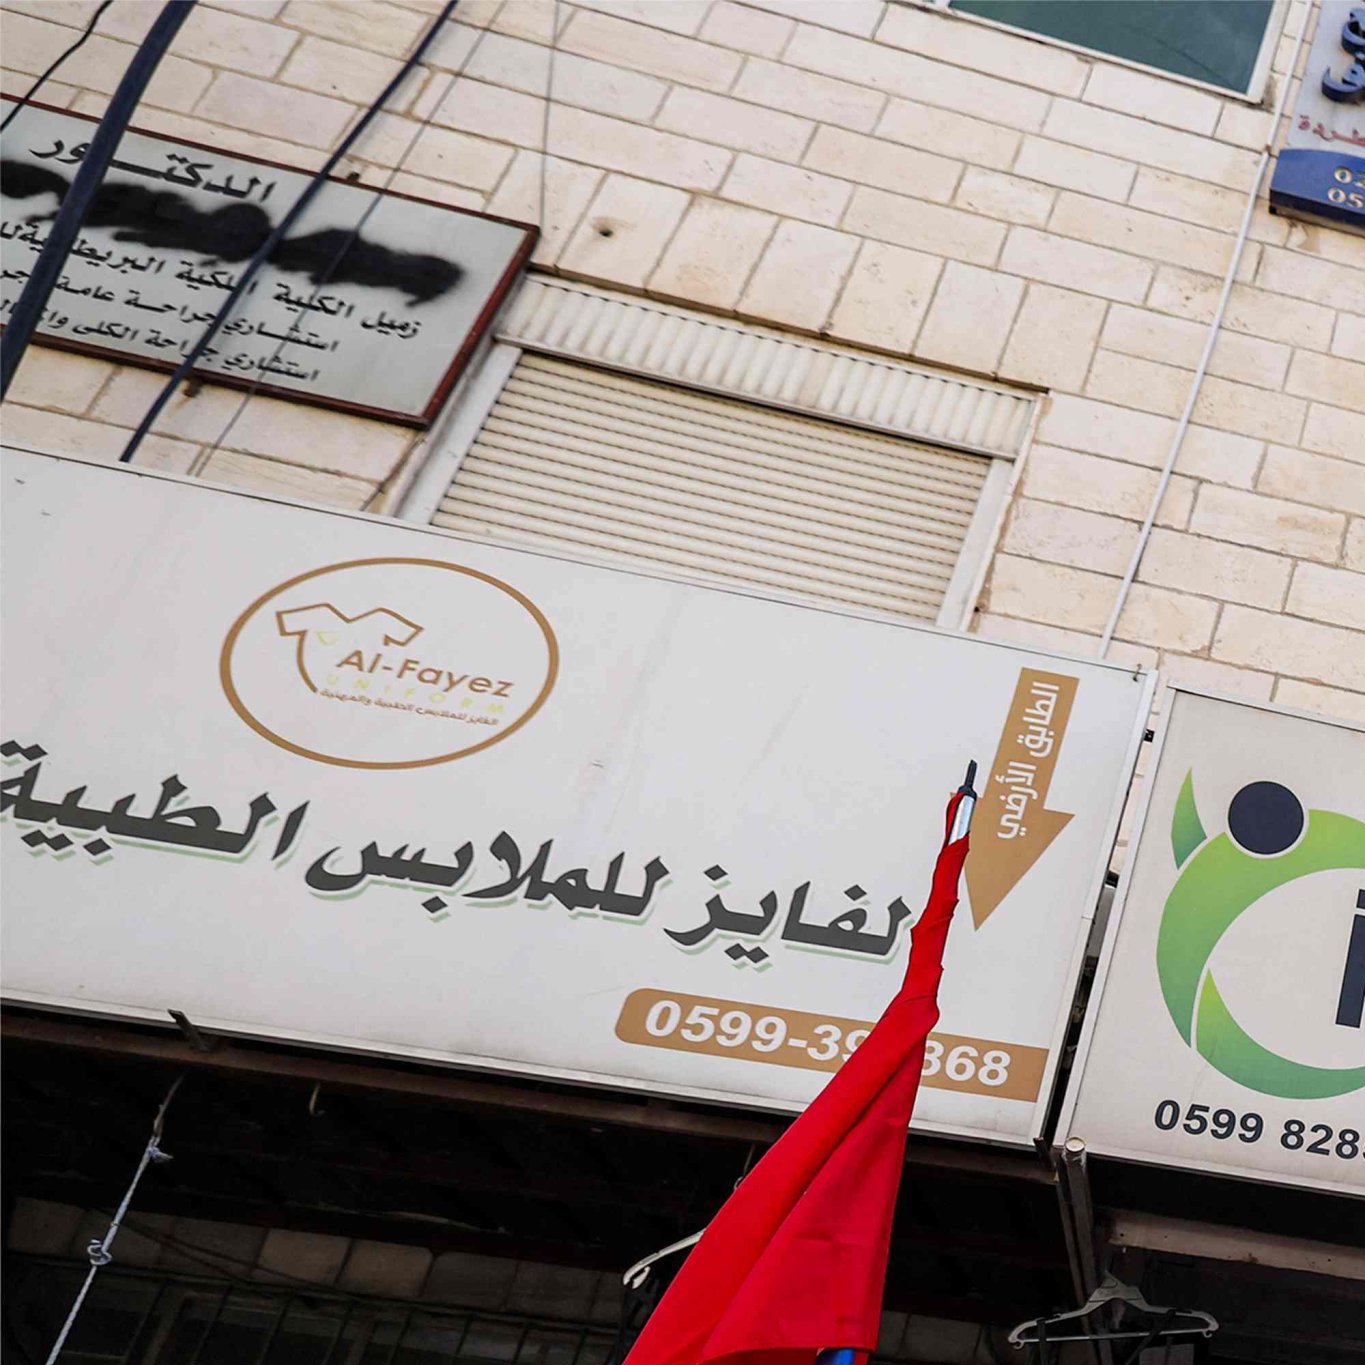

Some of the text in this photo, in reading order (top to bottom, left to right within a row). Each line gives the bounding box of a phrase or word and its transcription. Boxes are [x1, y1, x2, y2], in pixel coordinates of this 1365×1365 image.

[335, 650, 515, 699] Al-Fayez
[995, 681, 1060, 840] الطابق الأرضي
[304, 829, 670, 914] للملابس
[663, 863, 912, 965] لفايز
[1154, 1098, 1265, 1145] 0599
